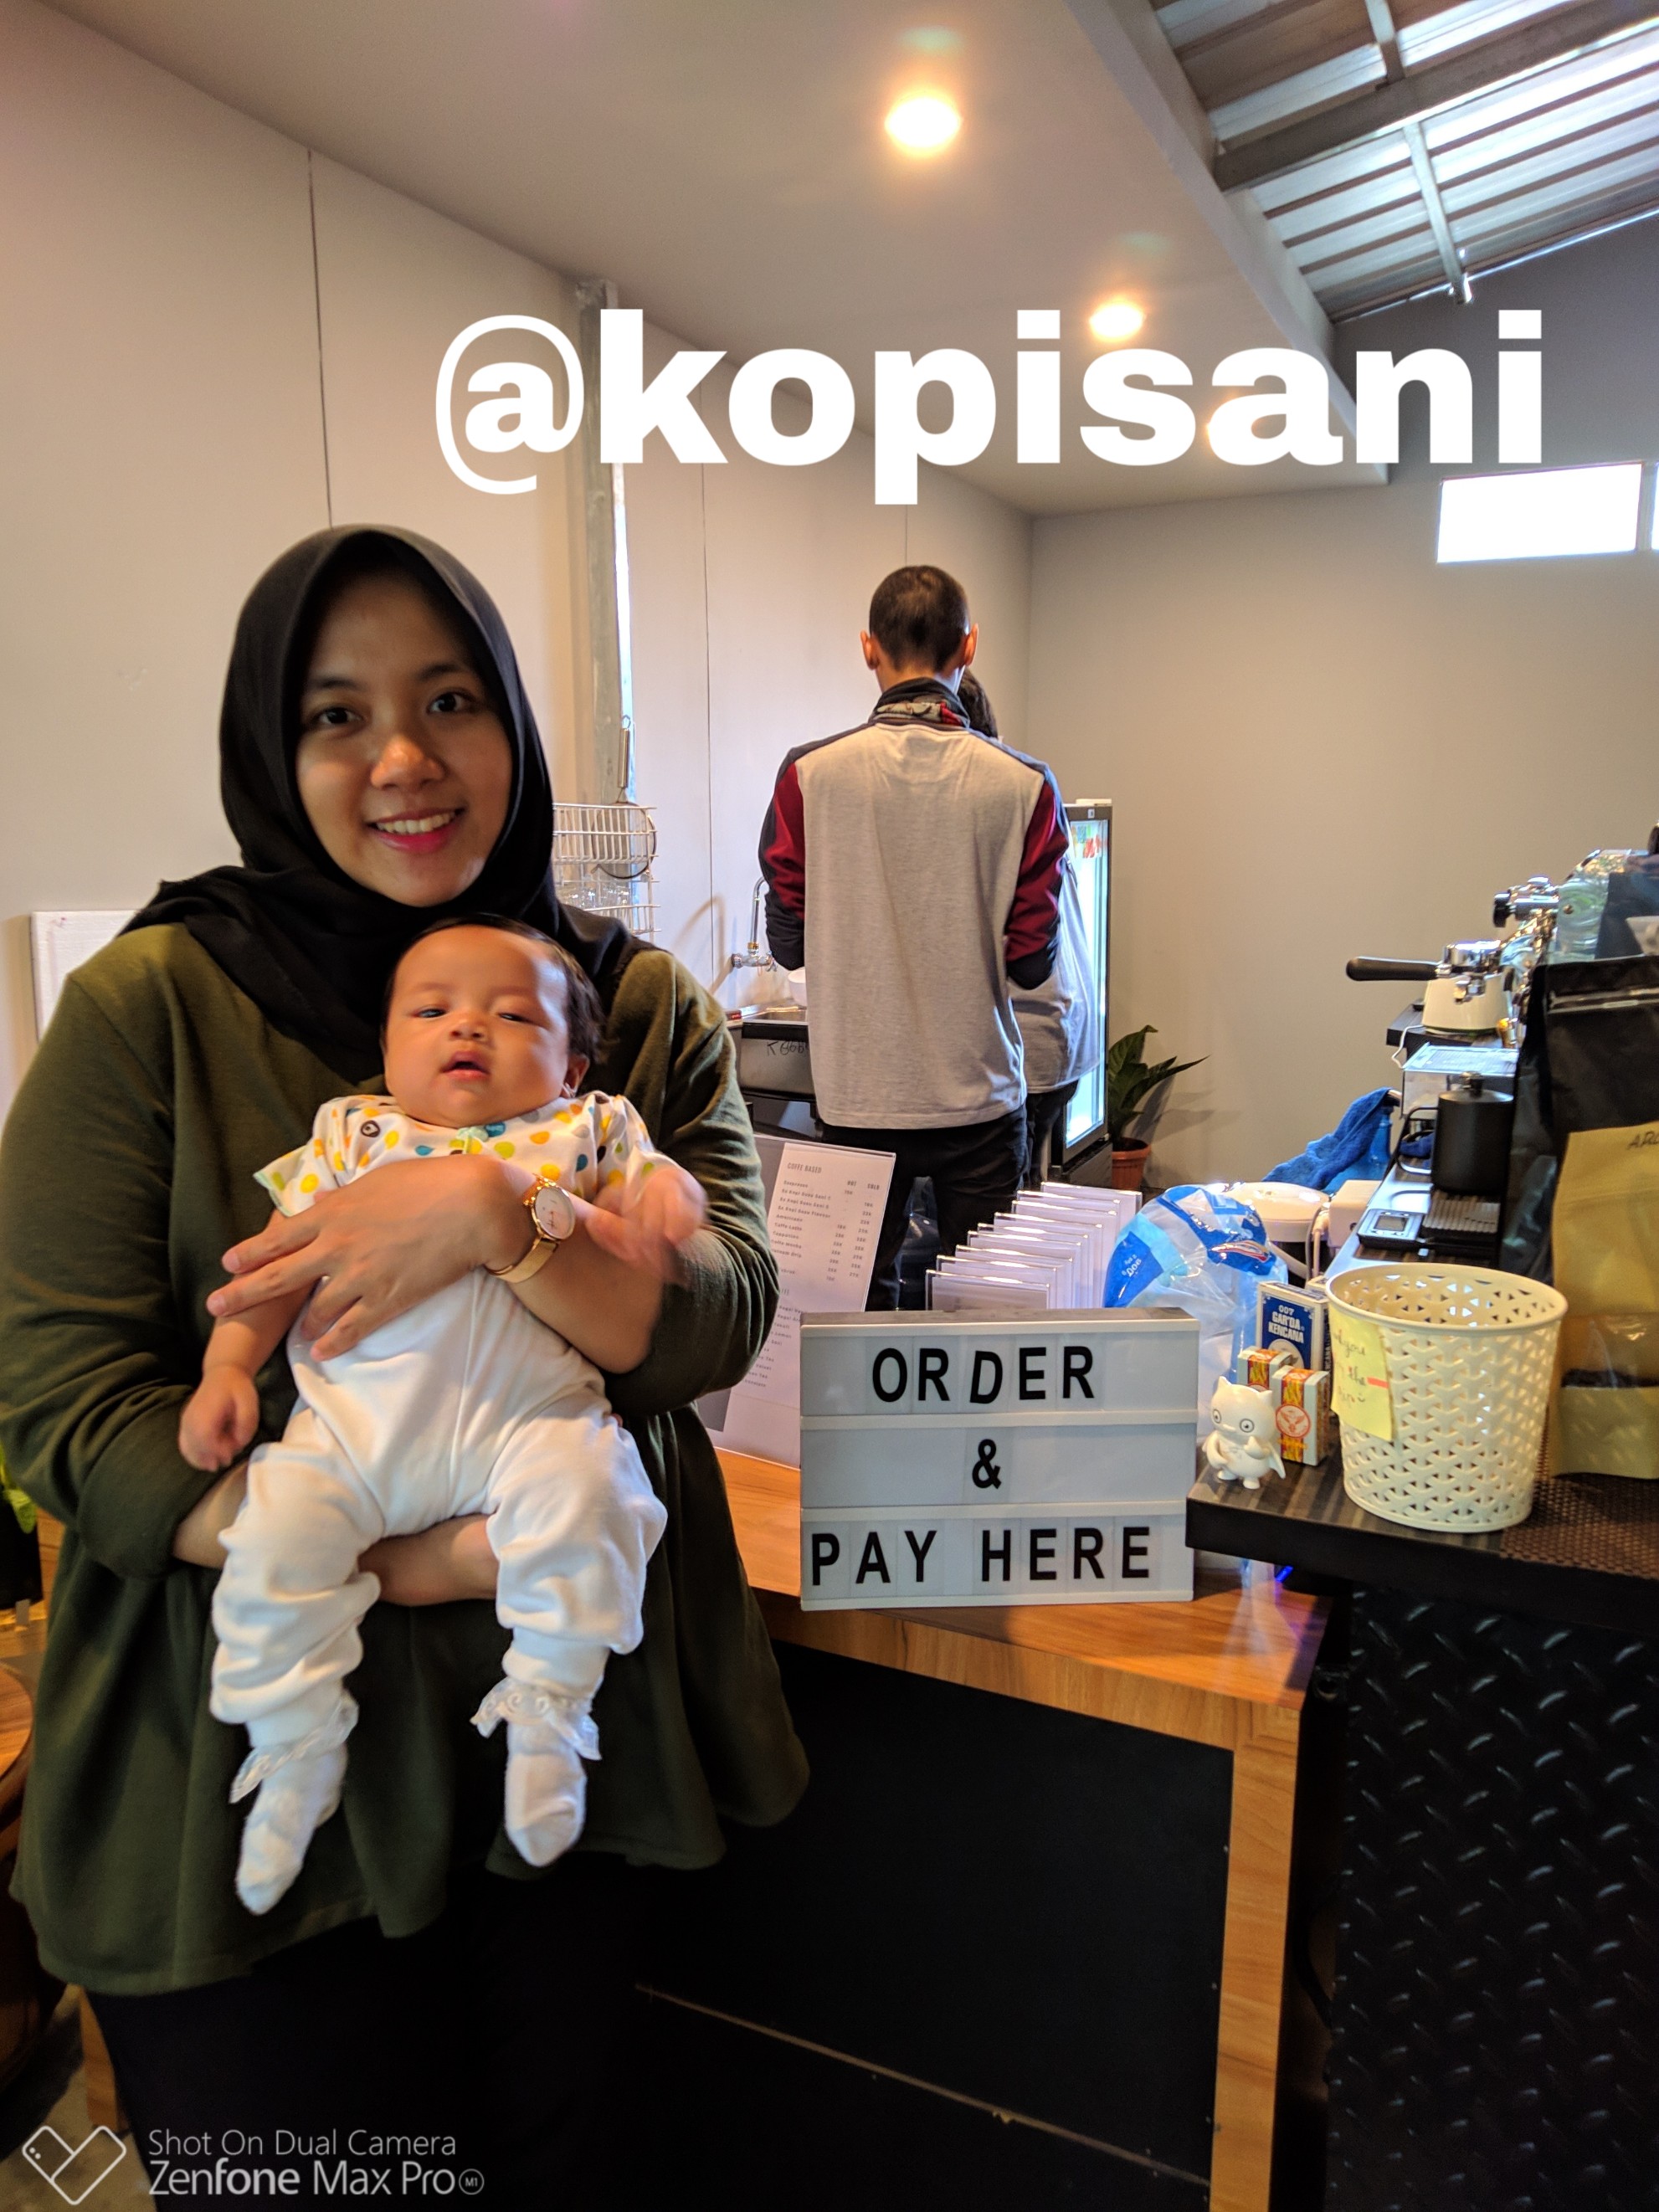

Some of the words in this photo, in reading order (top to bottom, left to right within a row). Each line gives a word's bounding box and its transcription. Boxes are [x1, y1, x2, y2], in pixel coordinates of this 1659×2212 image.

[804, 1164, 822, 1173] BASED
[1278, 1304, 1295, 1316] 007
[1268, 1322, 1304, 1344] KENCANA
[871, 1346, 1095, 1404] ORDER
[972, 1439, 1002, 1490] &
[811, 1530, 937, 1586] PAY
[981, 1527, 1151, 1582] HERE
